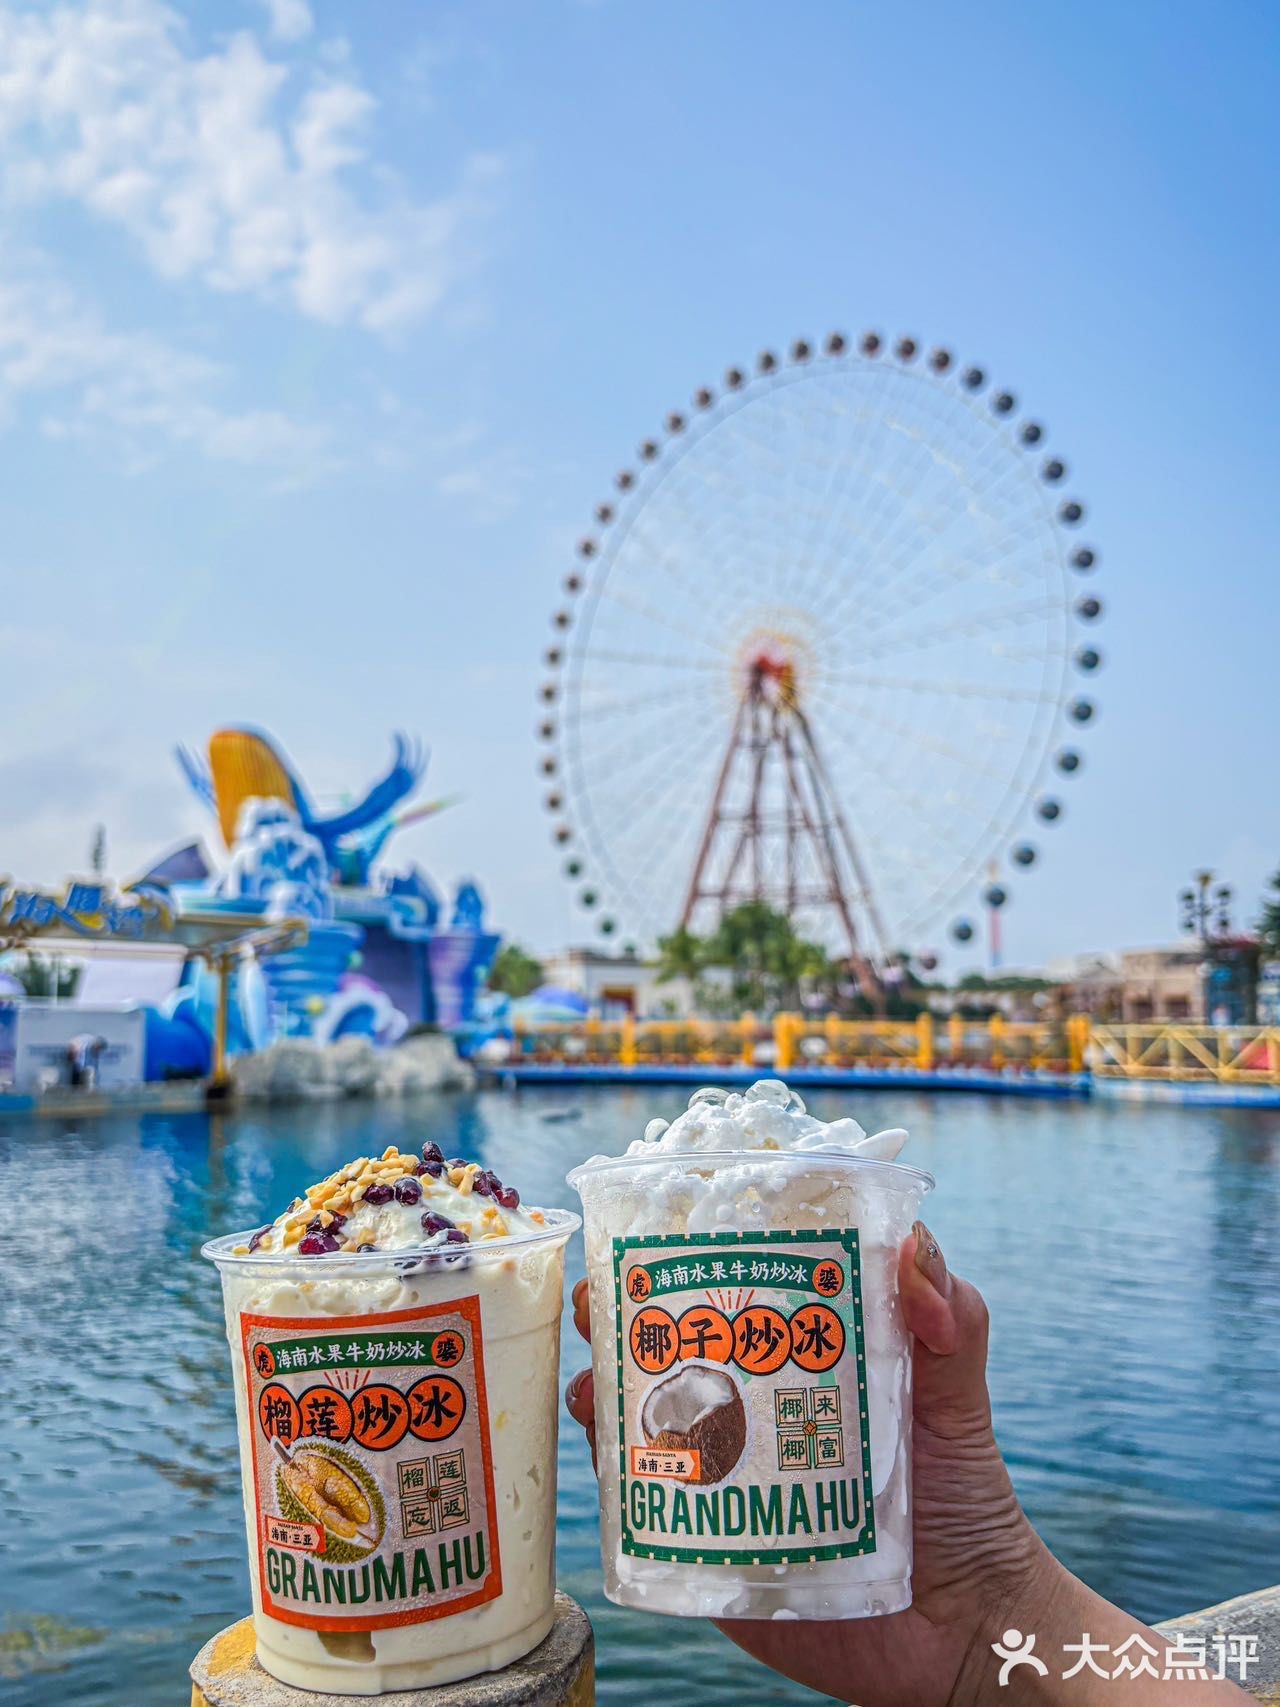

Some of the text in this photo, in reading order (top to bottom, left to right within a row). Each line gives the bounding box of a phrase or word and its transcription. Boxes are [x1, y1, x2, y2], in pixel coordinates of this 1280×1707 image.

[630, 1260, 839, 1297] 虎 海南水果牛奶炒冰 婆
[257, 1338, 457, 1374] 虎 海南水果牛奶炒冰 婆
[634, 1313, 838, 1365] 椰子炒冰
[263, 1385, 457, 1441] 榴莲炒冰
[638, 1457, 687, 1474] 海南·三亚
